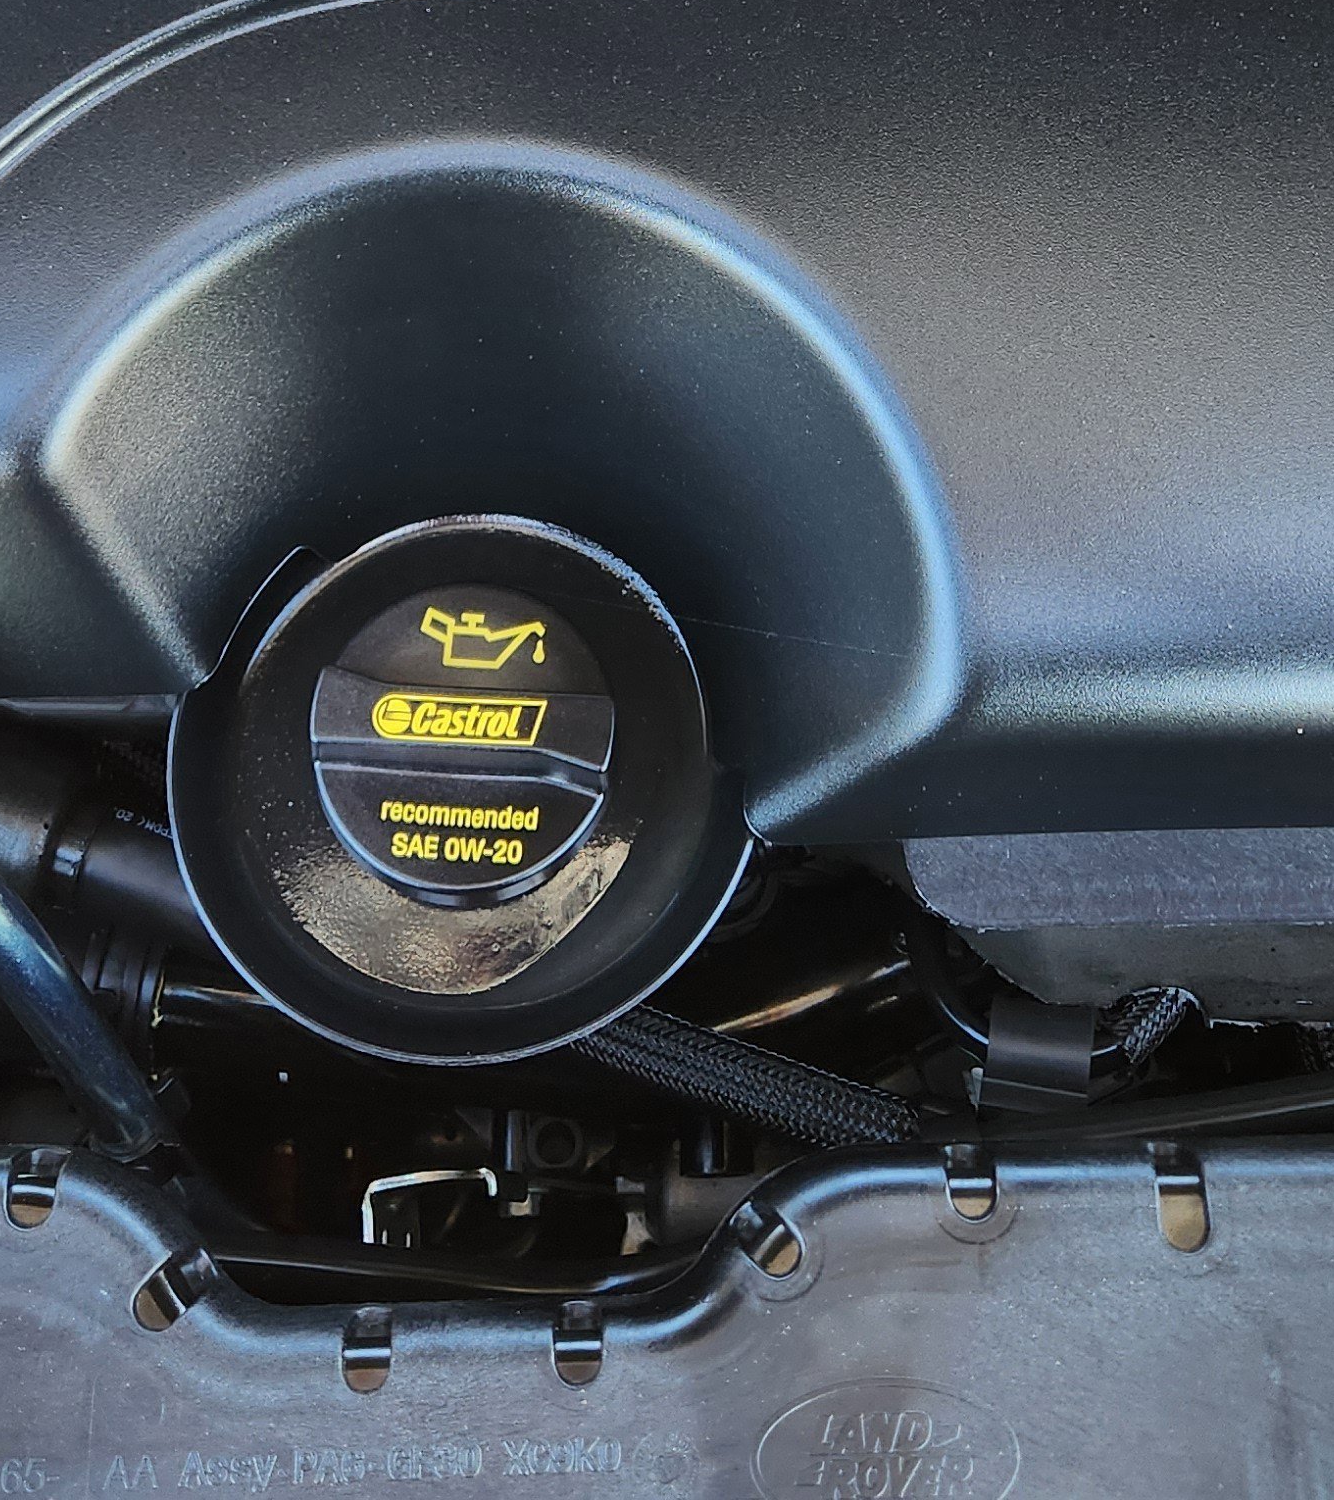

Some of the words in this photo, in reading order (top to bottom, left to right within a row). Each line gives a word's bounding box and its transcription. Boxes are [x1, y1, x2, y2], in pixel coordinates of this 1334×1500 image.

[411, 701, 522, 739] Castrol
[380, 799, 540, 832] recommended
[391, 831, 440, 860] SAE
[444, 836, 523, 865] 0W-20
[822, 1410, 933, 1454] LAND
[102, 1454, 158, 1490] AA
